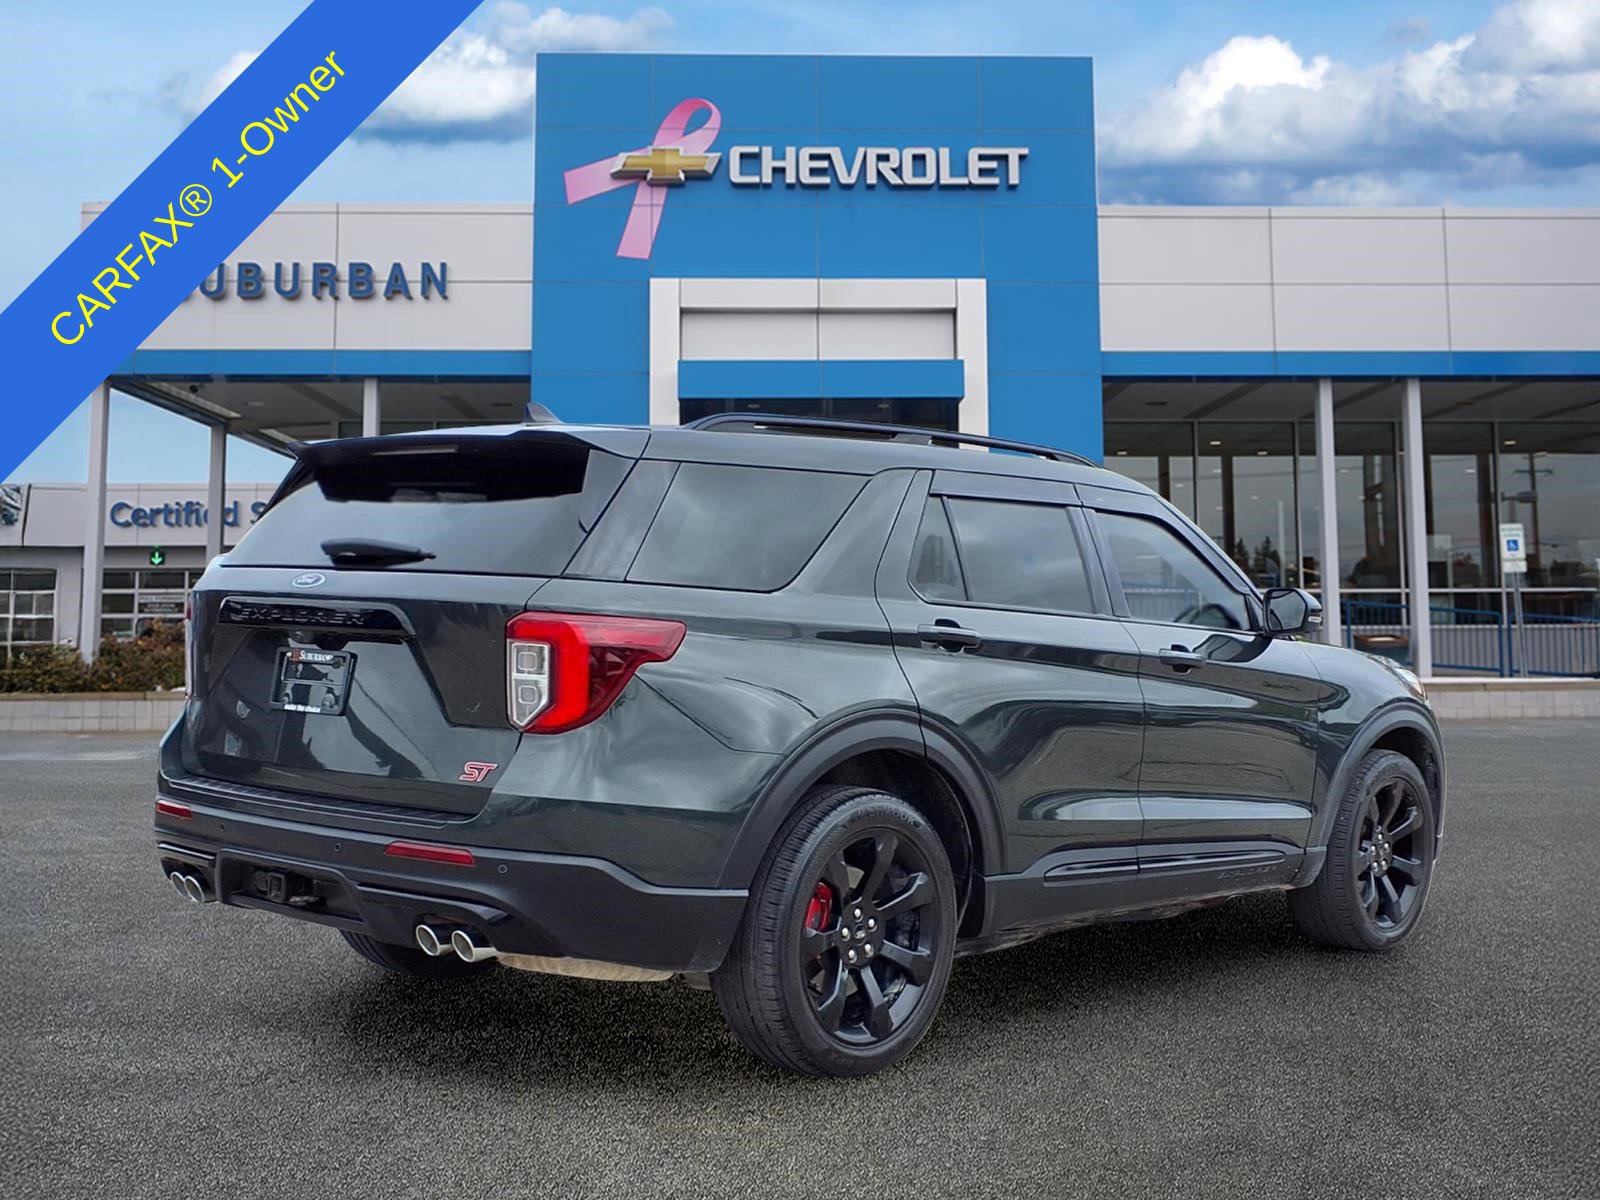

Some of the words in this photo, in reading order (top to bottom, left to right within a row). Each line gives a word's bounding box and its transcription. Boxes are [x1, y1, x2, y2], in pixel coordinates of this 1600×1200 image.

[729, 146, 1029, 185] CHEVROLET
[190, 261, 449, 300] UBURBAN
[240, 607, 364, 625] EXPLORER
[459, 761, 498, 782] ST
